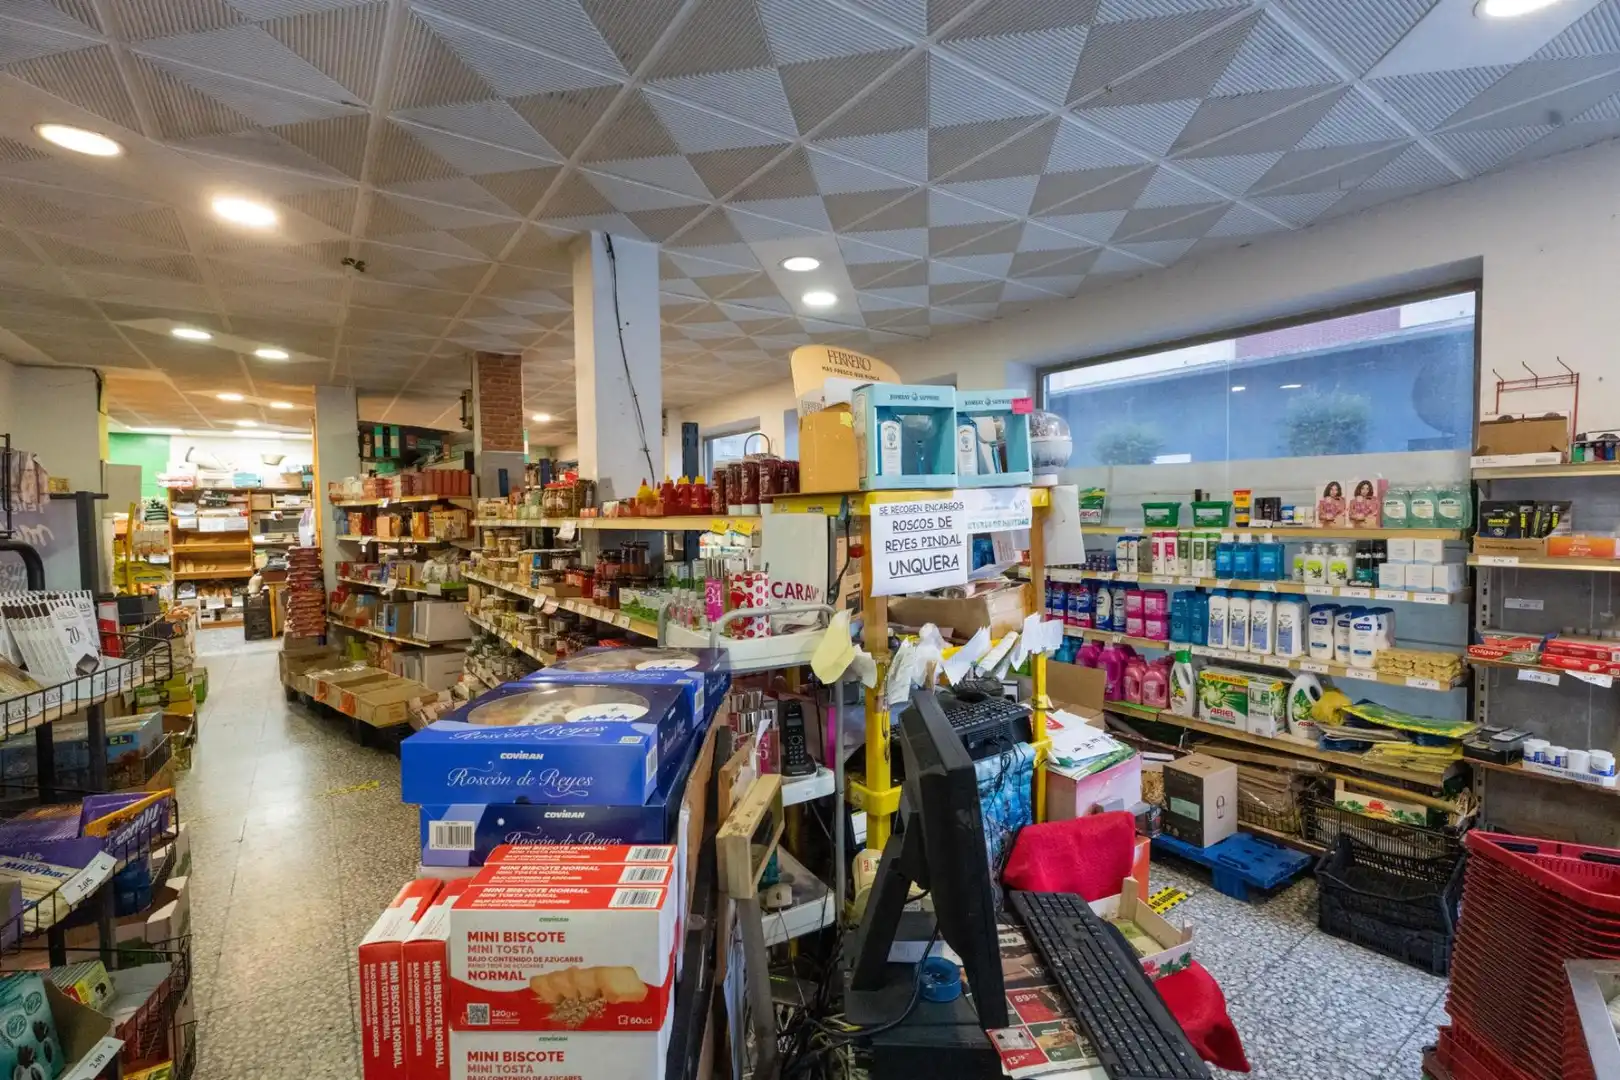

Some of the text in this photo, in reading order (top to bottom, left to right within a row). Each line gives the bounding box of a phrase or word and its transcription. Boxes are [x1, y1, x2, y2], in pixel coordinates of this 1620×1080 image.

[827, 350, 872, 372] FERRERO
[834, 368, 853, 376] FRESCO
[879, 501, 964, 514] SE RECOGEN ENCARGOS
[892, 516, 952, 531] ROSCOS DE
[886, 534, 962, 551] REYES PINDAL
[888, 554, 959, 576] UNQUERA
[65, 626, 80, 645] 70
[1469, 647, 1504, 657] Colgate
[1210, 708, 1234, 717] ARIEL
[447, 761, 594, 798] Roscón de Reyes
[467, 932, 565, 943] MINI BISCOTE
[467, 945, 534, 954] MINI TOSTA
[468, 971, 526, 981] NORMAL
[389, 961, 402, 1068] MINI BISCOTE NORMAL
[432, 961, 444, 1068] MINI BISCOTE NORMAL
[467, 1051, 564, 1062] MINI BISCOTE
[467, 1064, 534, 1074] MINI TOSTA
